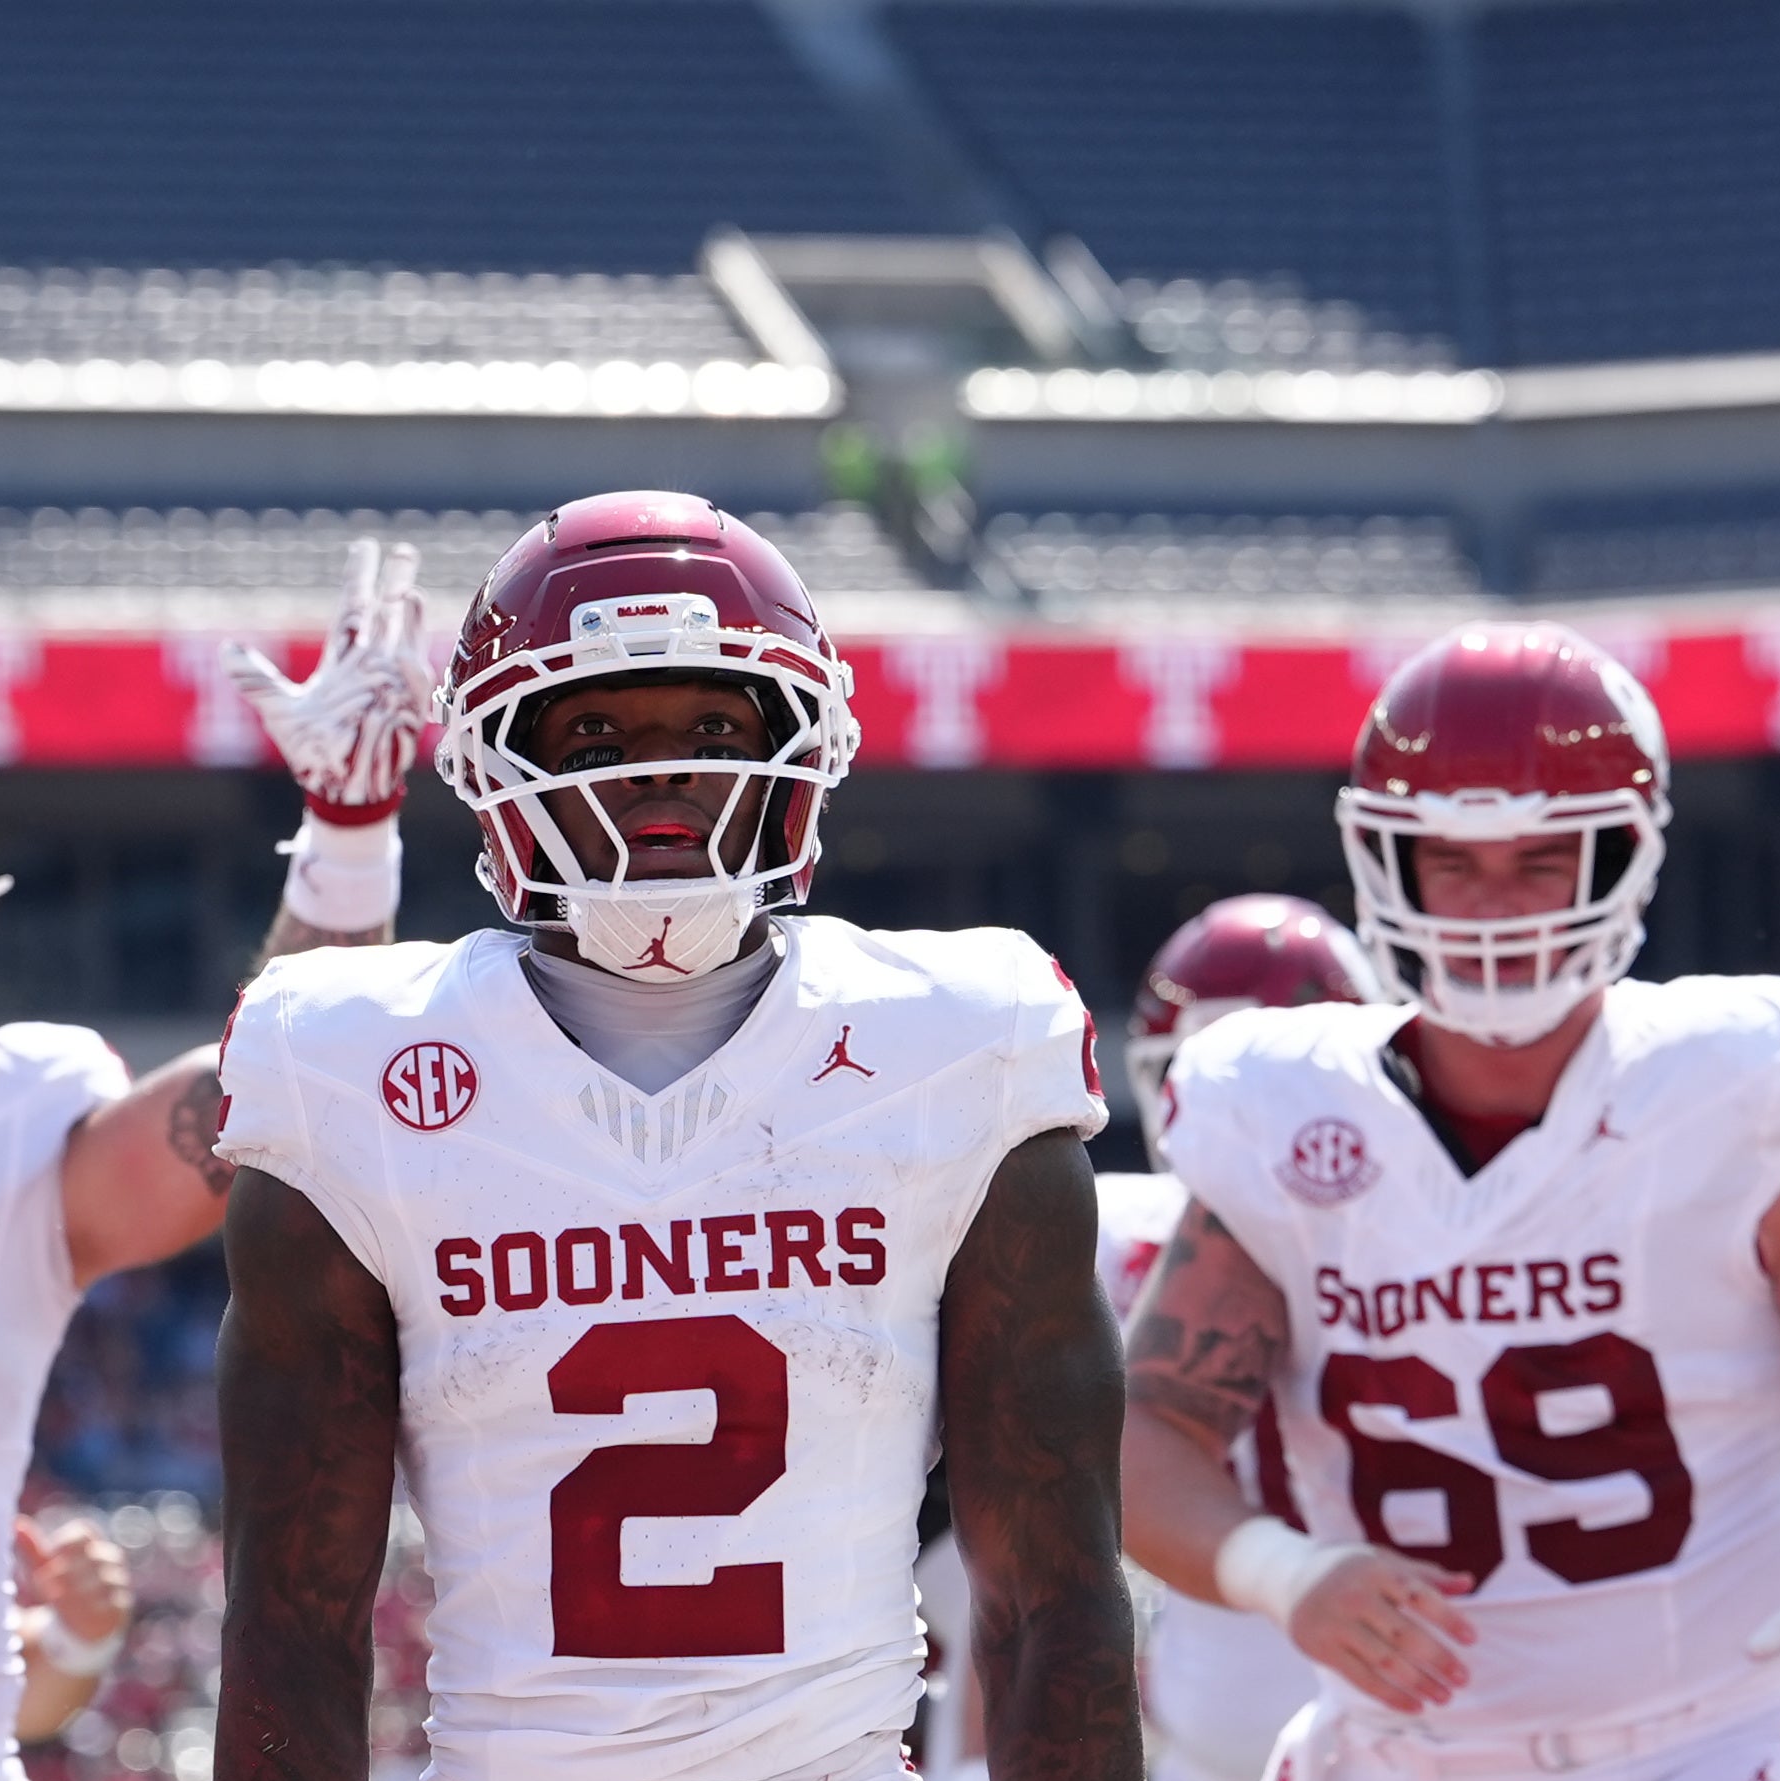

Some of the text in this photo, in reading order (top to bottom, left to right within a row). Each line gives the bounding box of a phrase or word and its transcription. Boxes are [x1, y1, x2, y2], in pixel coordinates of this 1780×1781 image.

[883, 638, 1007, 769] T
[1119, 638, 1241, 769] T
[389, 1046, 477, 1129] SEC
[1295, 1121, 1364, 1185] SEC
[435, 1206, 888, 1318] SOONERS
[547, 1313, 790, 1659] 2
[1320, 1330, 1695, 1596] 69
